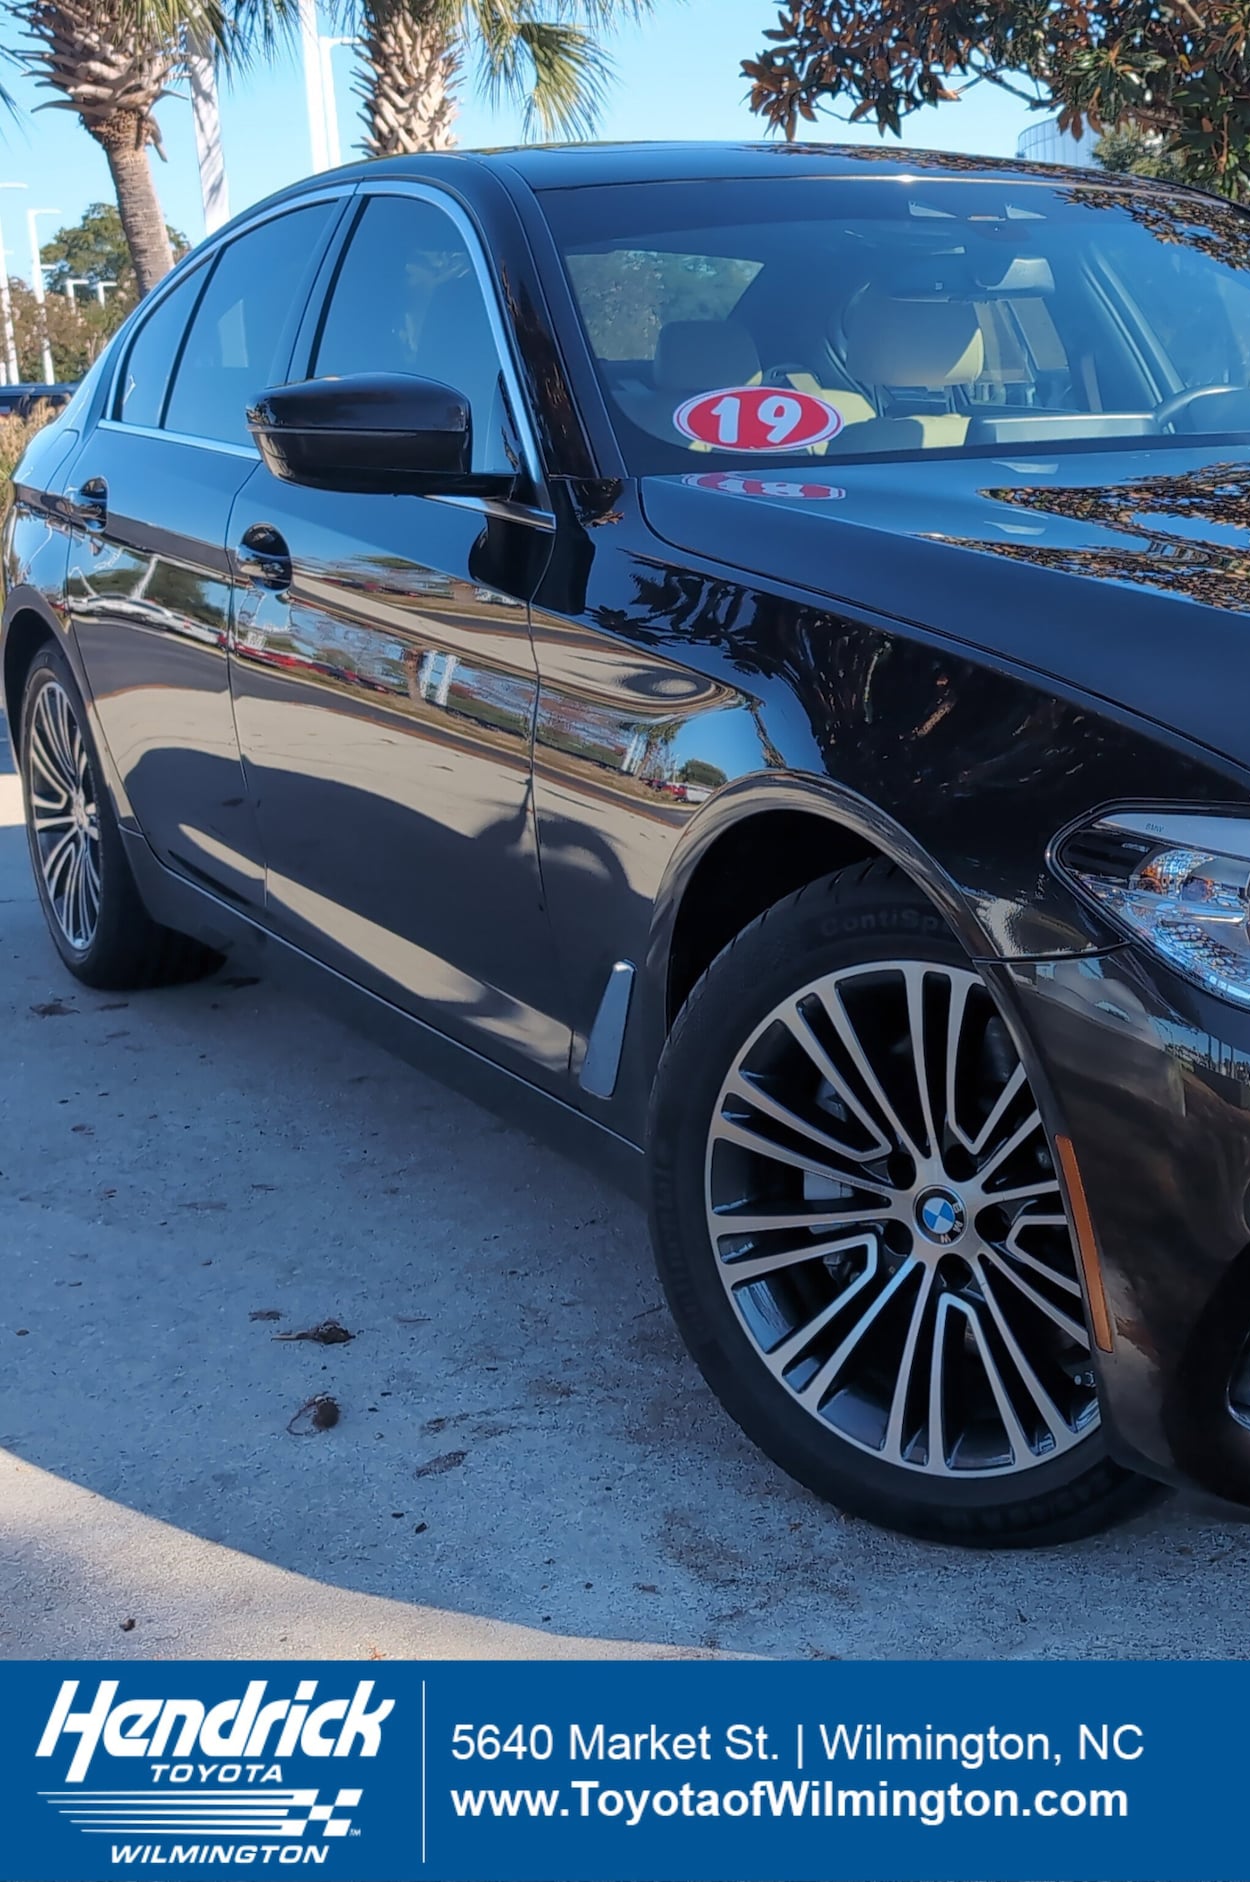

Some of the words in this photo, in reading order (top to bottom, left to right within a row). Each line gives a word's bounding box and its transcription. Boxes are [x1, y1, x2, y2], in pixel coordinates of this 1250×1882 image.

[711, 395, 802, 444] 19
[819, 908, 951, 937] ContiSp
[940, 1202, 964, 1244] BMW
